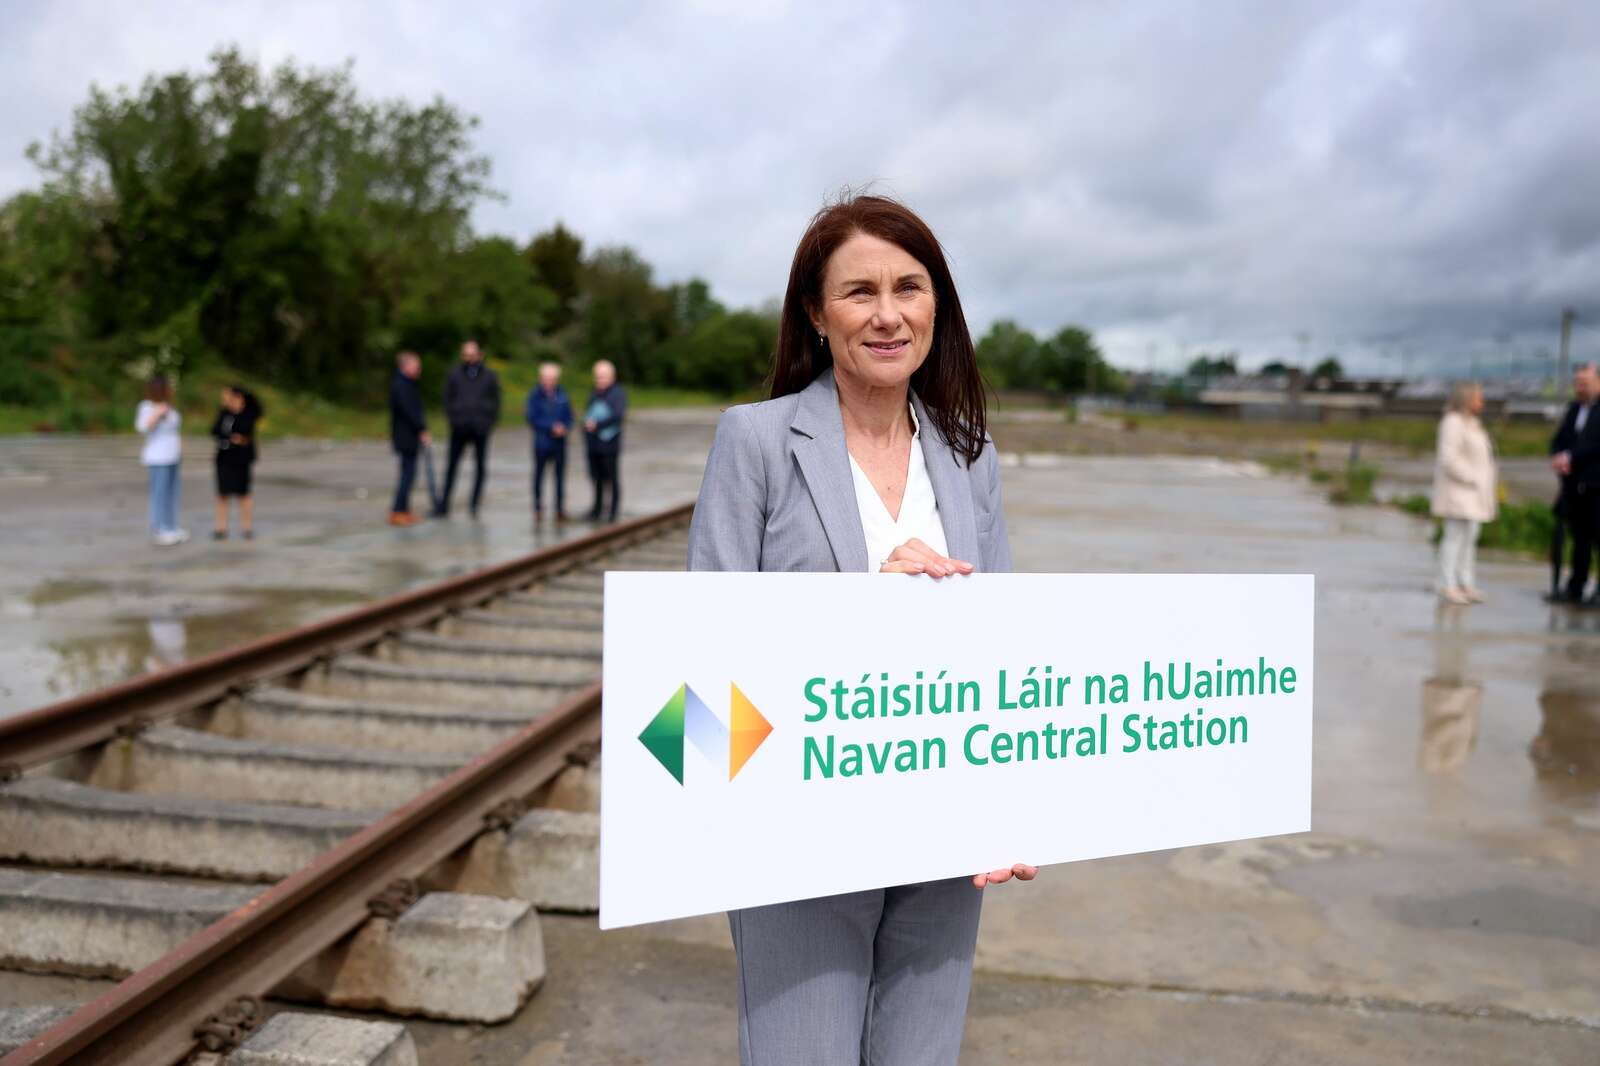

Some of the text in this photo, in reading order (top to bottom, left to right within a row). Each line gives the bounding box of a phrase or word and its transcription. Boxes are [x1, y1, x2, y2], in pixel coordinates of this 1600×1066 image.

[803, 656, 1297, 723] Stáisiún Láir na hUaimhe
[803, 707, 1248, 781] Navan Central Station
